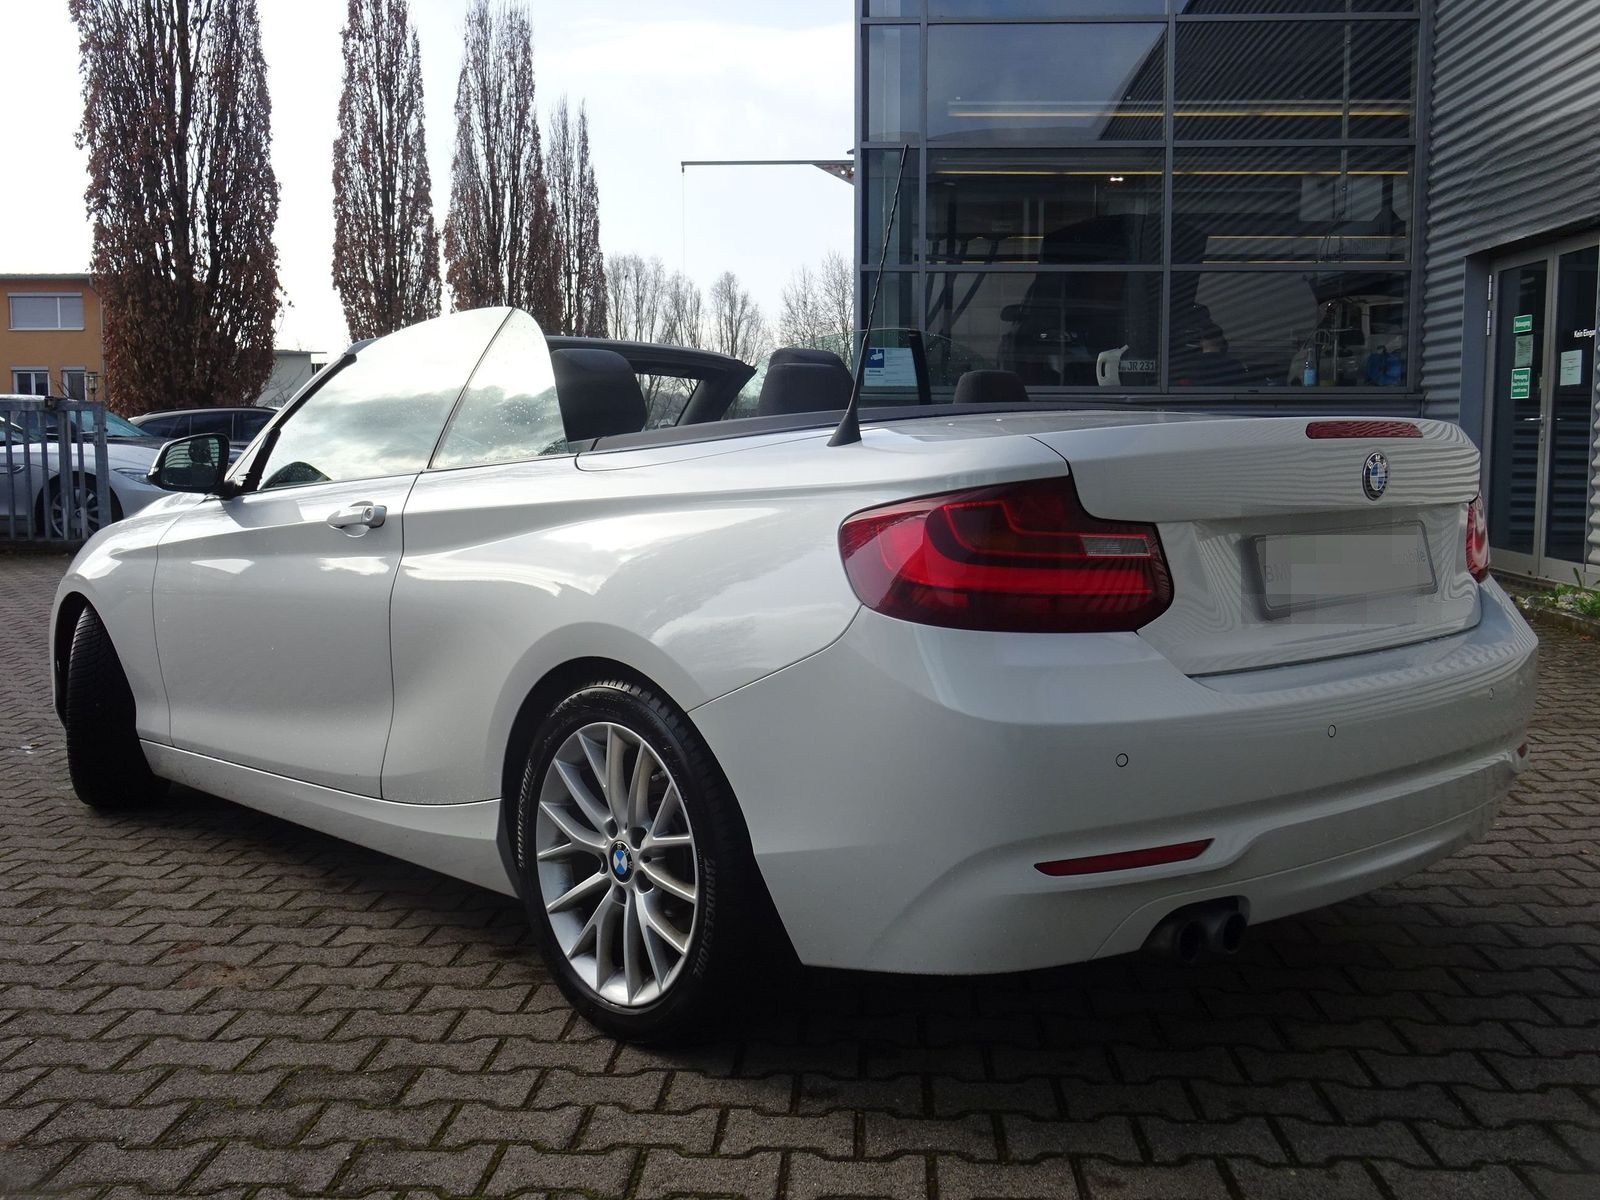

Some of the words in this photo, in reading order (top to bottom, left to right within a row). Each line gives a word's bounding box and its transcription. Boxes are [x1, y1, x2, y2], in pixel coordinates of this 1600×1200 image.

[1139, 361, 1154, 371] 231
[1367, 454, 1387, 469] BMW
[616, 841, 633, 869] BMW
